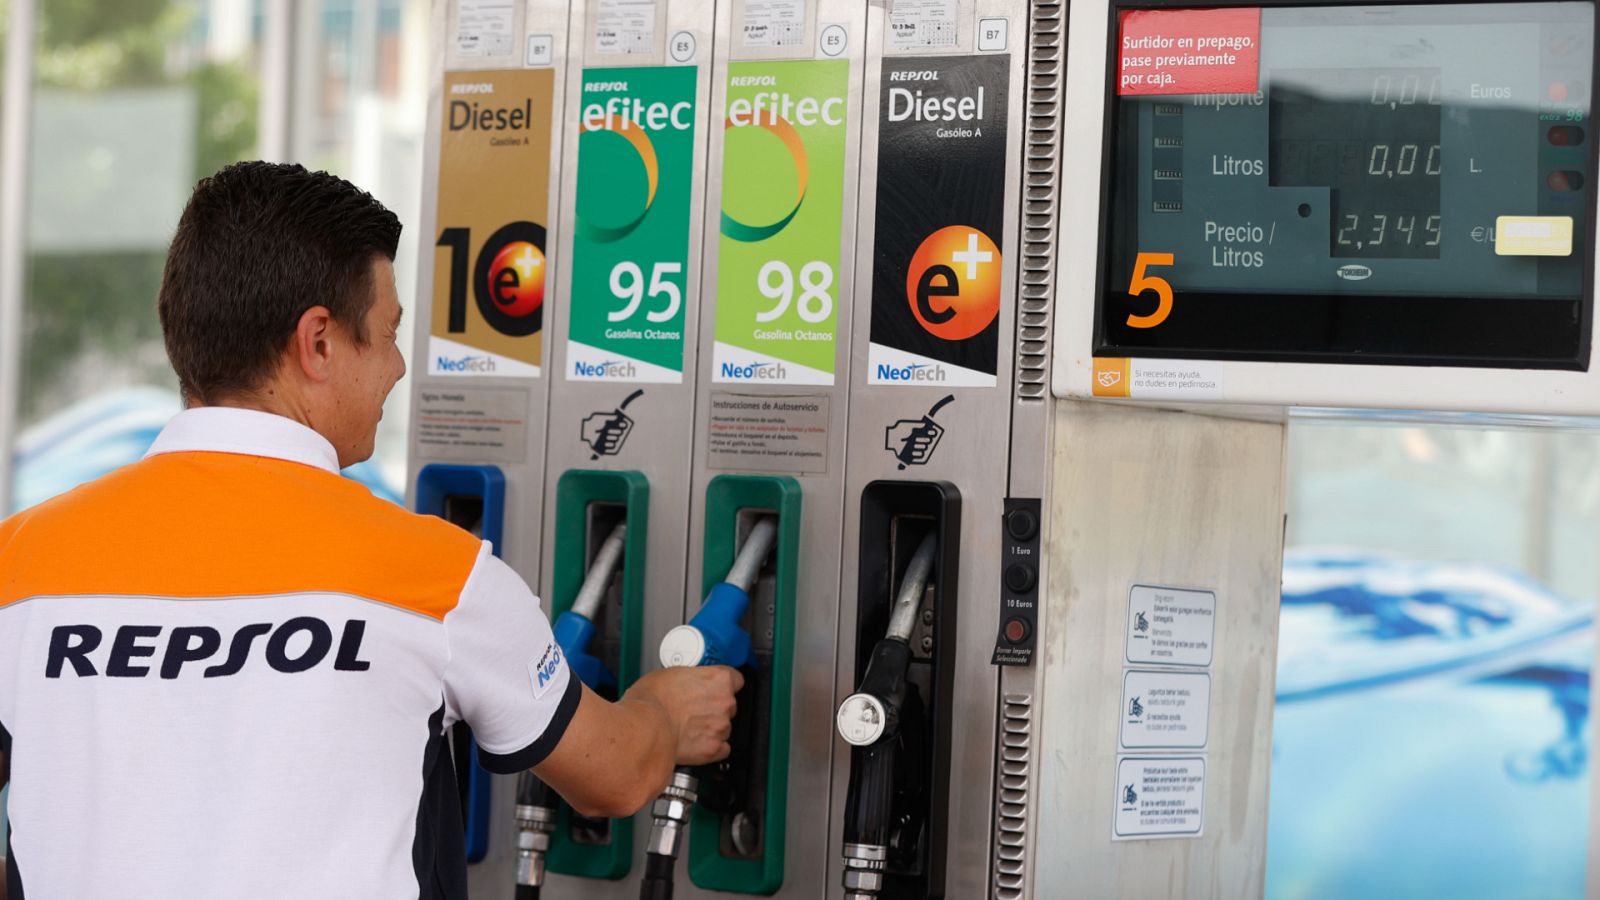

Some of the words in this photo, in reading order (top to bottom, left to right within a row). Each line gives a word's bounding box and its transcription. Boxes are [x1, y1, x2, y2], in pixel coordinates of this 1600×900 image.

[827, 36, 840, 46] E5
[986, 31, 1000, 40] B7
[1123, 35, 1174, 49] Surtidor
[1177, 37, 1193, 48] en
[1197, 36, 1254, 51] prepago,
[676, 42, 689, 51] E5
[1122, 55, 1152, 70] pase
[1155, 53, 1236, 69] previamente
[730, 76, 777, 86] REPSOL
[890, 70, 940, 81] REPSOL
[1121, 74, 1143, 88] por
[1147, 72, 1176, 87] caja.
[450, 83, 494, 94] REPSOL
[584, 81, 629, 92] REPSOL
[1470, 84, 1512, 98] Euros
[729, 92, 843, 127] efitec
[888, 86, 984, 122] Diesel
[449, 97, 533, 131] Diesel
[582, 97, 692, 131] efitec
[936, 127, 973, 138] Gasóleo
[974, 128, 982, 138] A
[1212, 155, 1264, 176] Litros
[1205, 221, 1263, 243] Precio
[1268, 220, 1276, 245] /
[1212, 246, 1264, 267] Litros
[436, 221, 547, 337] 10
[607, 261, 682, 323] 95
[756, 260, 834, 323] 98
[1126, 252, 1174, 329] 5
[605, 328, 642, 339] Gasolina
[644, 329, 681, 340] Octanos
[753, 329, 792, 341] Gasolina
[794, 330, 833, 341] Octanos
[436, 355, 497, 373] NeoTech
[574, 360, 636, 378] NeoTech
[722, 361, 786, 379] NeoTech
[877, 362, 946, 381] NeoTech
[1143, 370, 1176, 378] necesitas
[713, 400, 760, 410] Instrucciones
[762, 401, 771, 410] de
[773, 402, 819, 412] Autoservicio
[1016, 547, 1031, 555] Euro
[1007, 599, 1014, 607] 10
[1016, 600, 1033, 608] Euros
[45, 616, 372, 679] REPSOL
